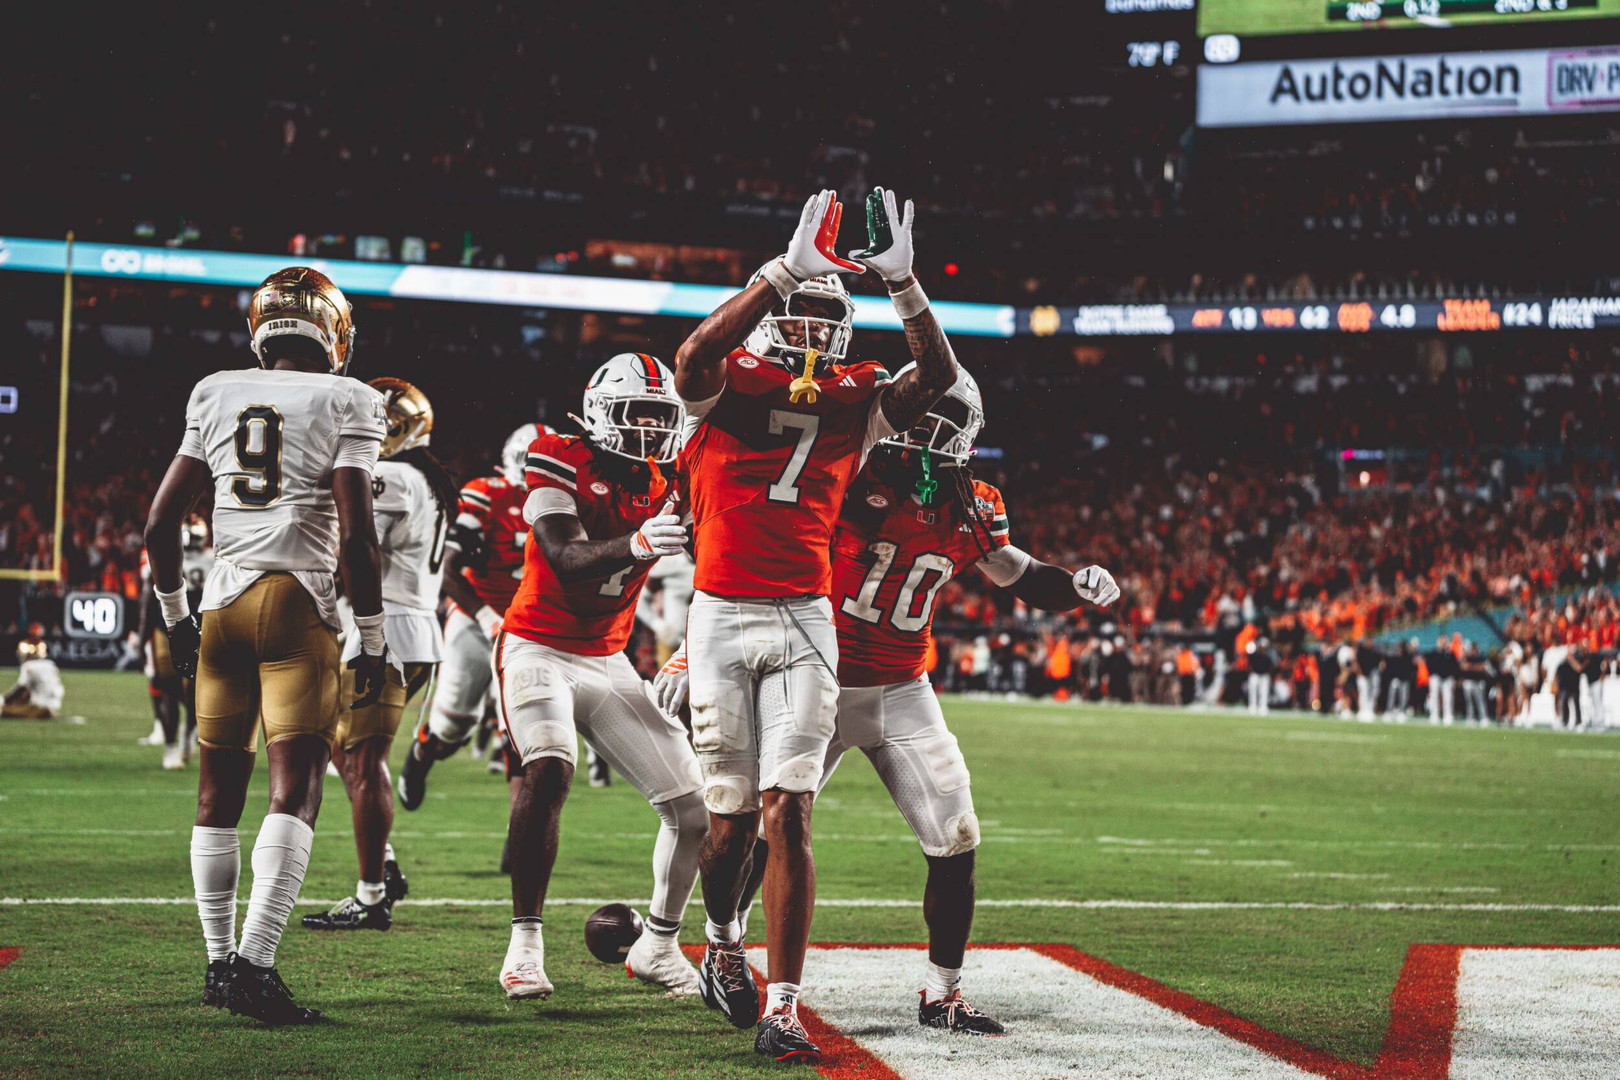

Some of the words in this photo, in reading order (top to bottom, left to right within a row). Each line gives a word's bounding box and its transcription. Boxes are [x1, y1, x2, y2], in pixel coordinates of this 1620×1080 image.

[1269, 55, 1521, 105] AutoNation
[268, 320, 298, 331] IRISH
[231, 404, 284, 508] 9
[767, 408, 820, 503] 7
[72, 597, 117, 635] 40
[840, 540, 955, 634] 10
